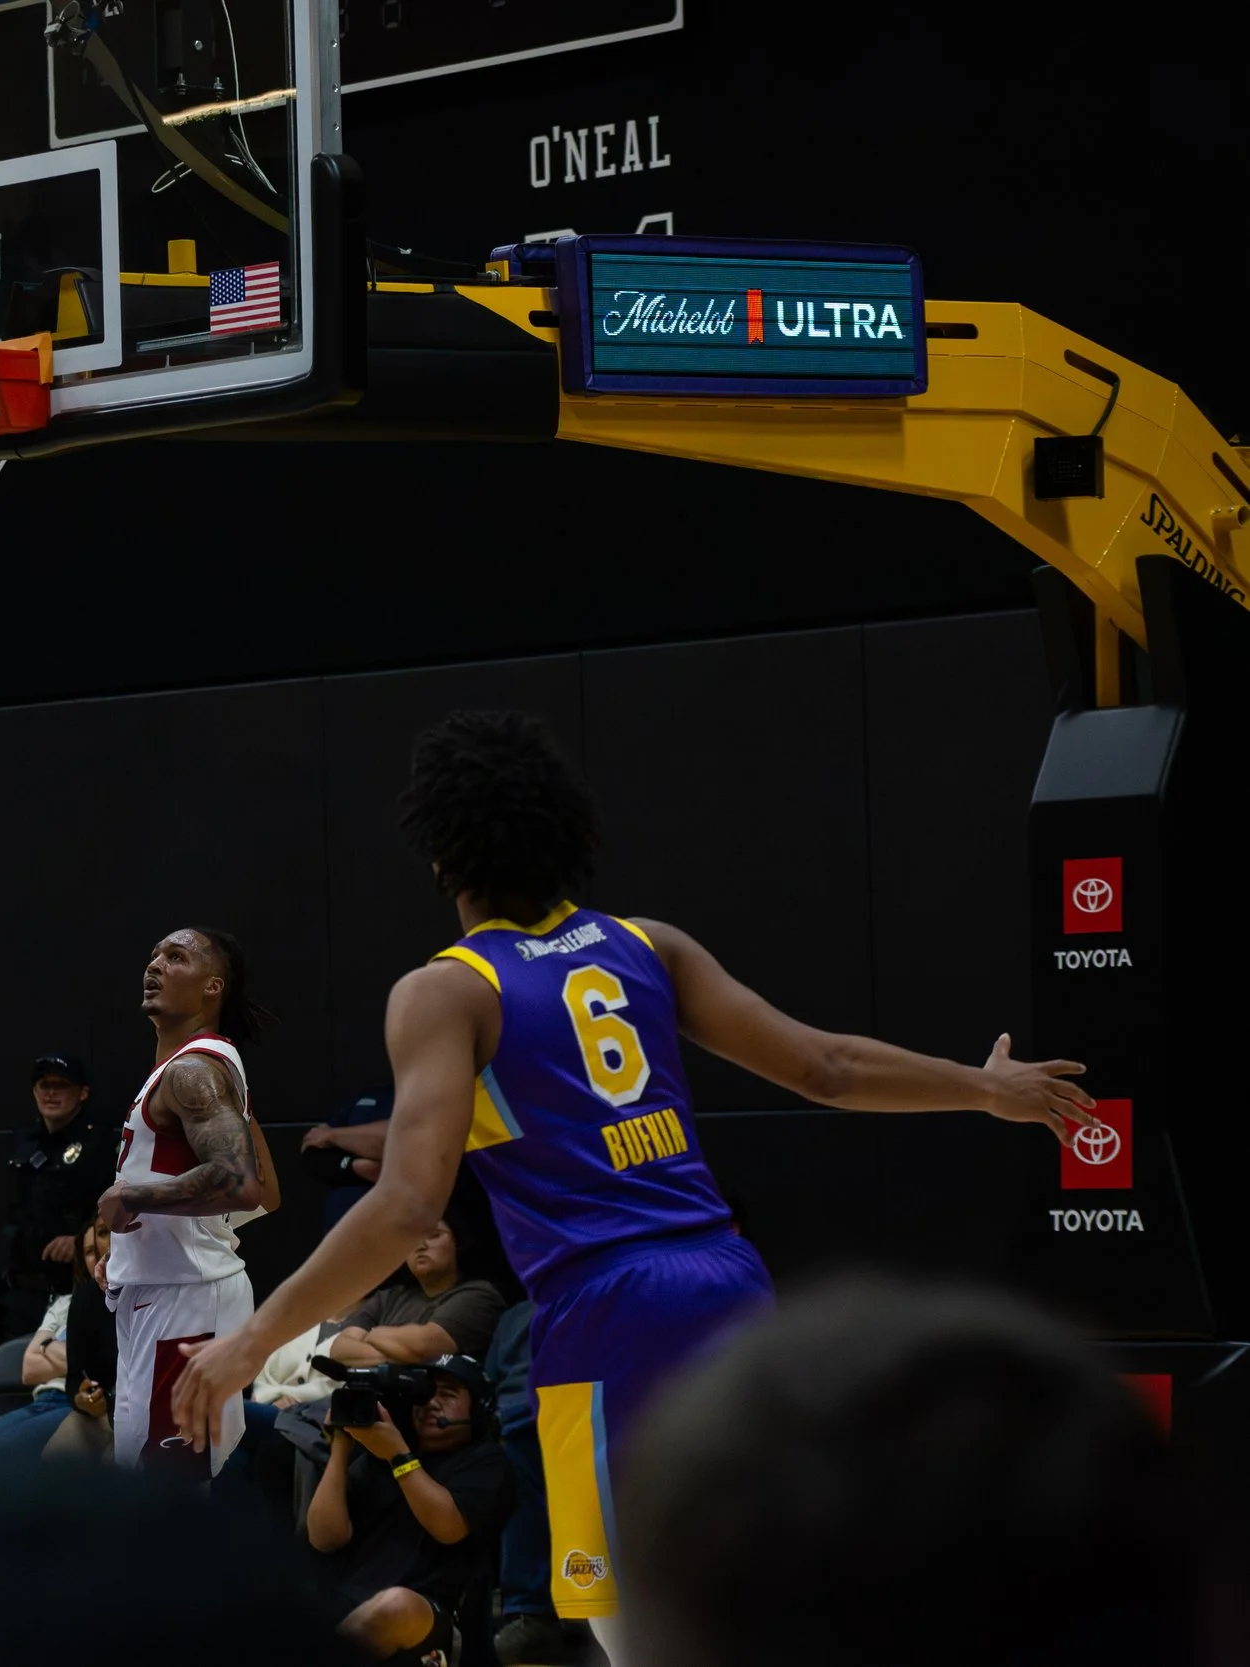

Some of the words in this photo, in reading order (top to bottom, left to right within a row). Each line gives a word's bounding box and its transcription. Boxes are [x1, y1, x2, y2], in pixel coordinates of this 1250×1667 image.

[529, 115, 671, 188] O'NEAL
[602, 291, 735, 336] Michelob
[776, 300, 905, 339] ULTRA
[1053, 948, 1133, 970] TOYOTA
[562, 963, 651, 1108] 6
[601, 1107, 689, 1172] BUFKIN
[1048, 1209, 1145, 1232] TOYOTA
